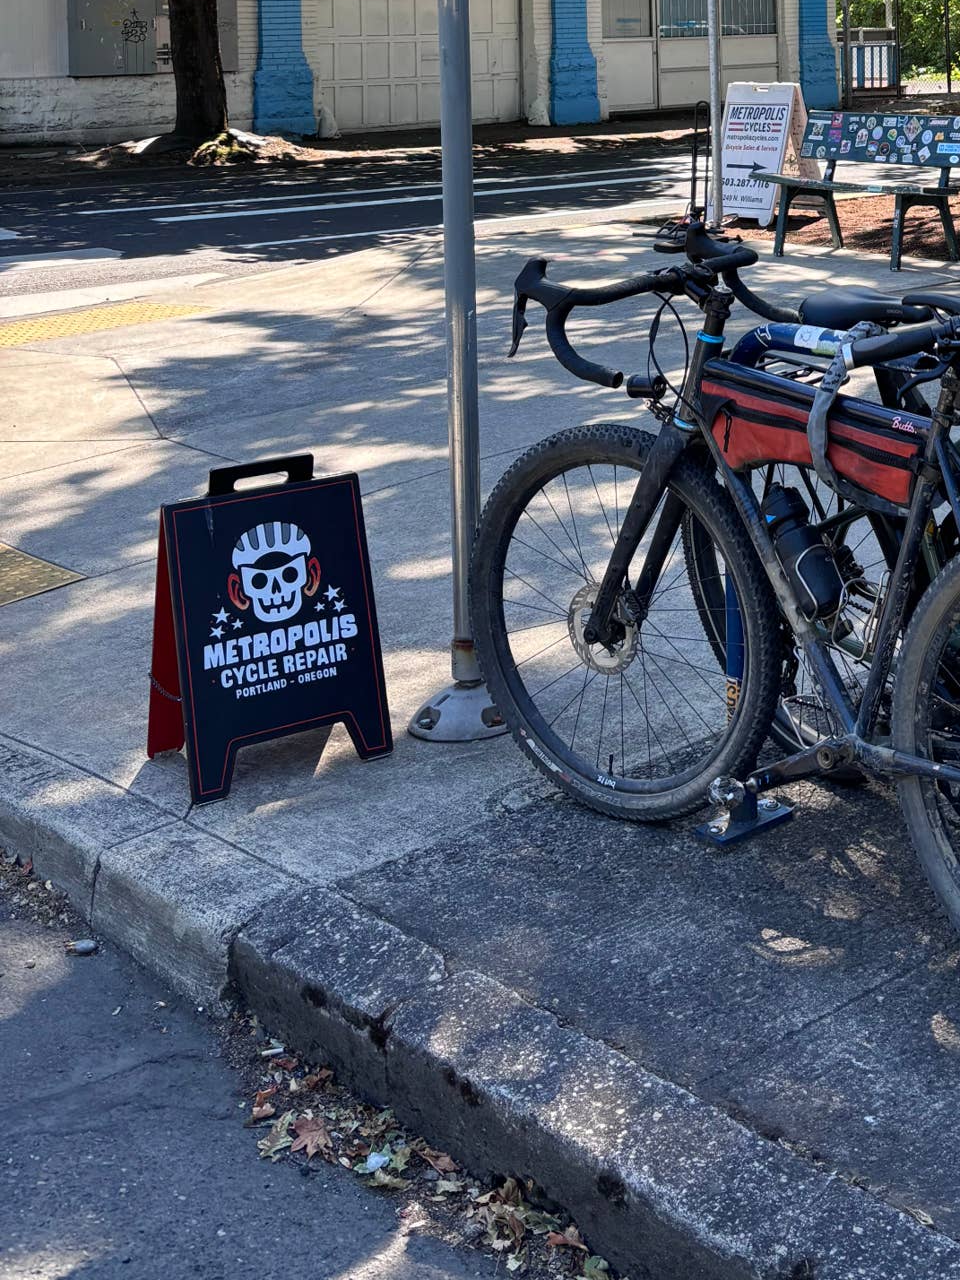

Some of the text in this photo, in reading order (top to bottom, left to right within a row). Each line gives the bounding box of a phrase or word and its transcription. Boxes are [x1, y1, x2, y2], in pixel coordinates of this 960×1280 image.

[729, 107, 786, 120] METROPOLIS
[727, 134, 779, 142] metropoliscycles.com
[744, 123, 772, 132] CYCLES
[204, 613, 358, 670] METROPOLIS
[221, 644, 348, 688] CYCLE REPAIR
[236, 678, 287, 698] PORTLAND
[298, 667, 337, 684] OREGON
